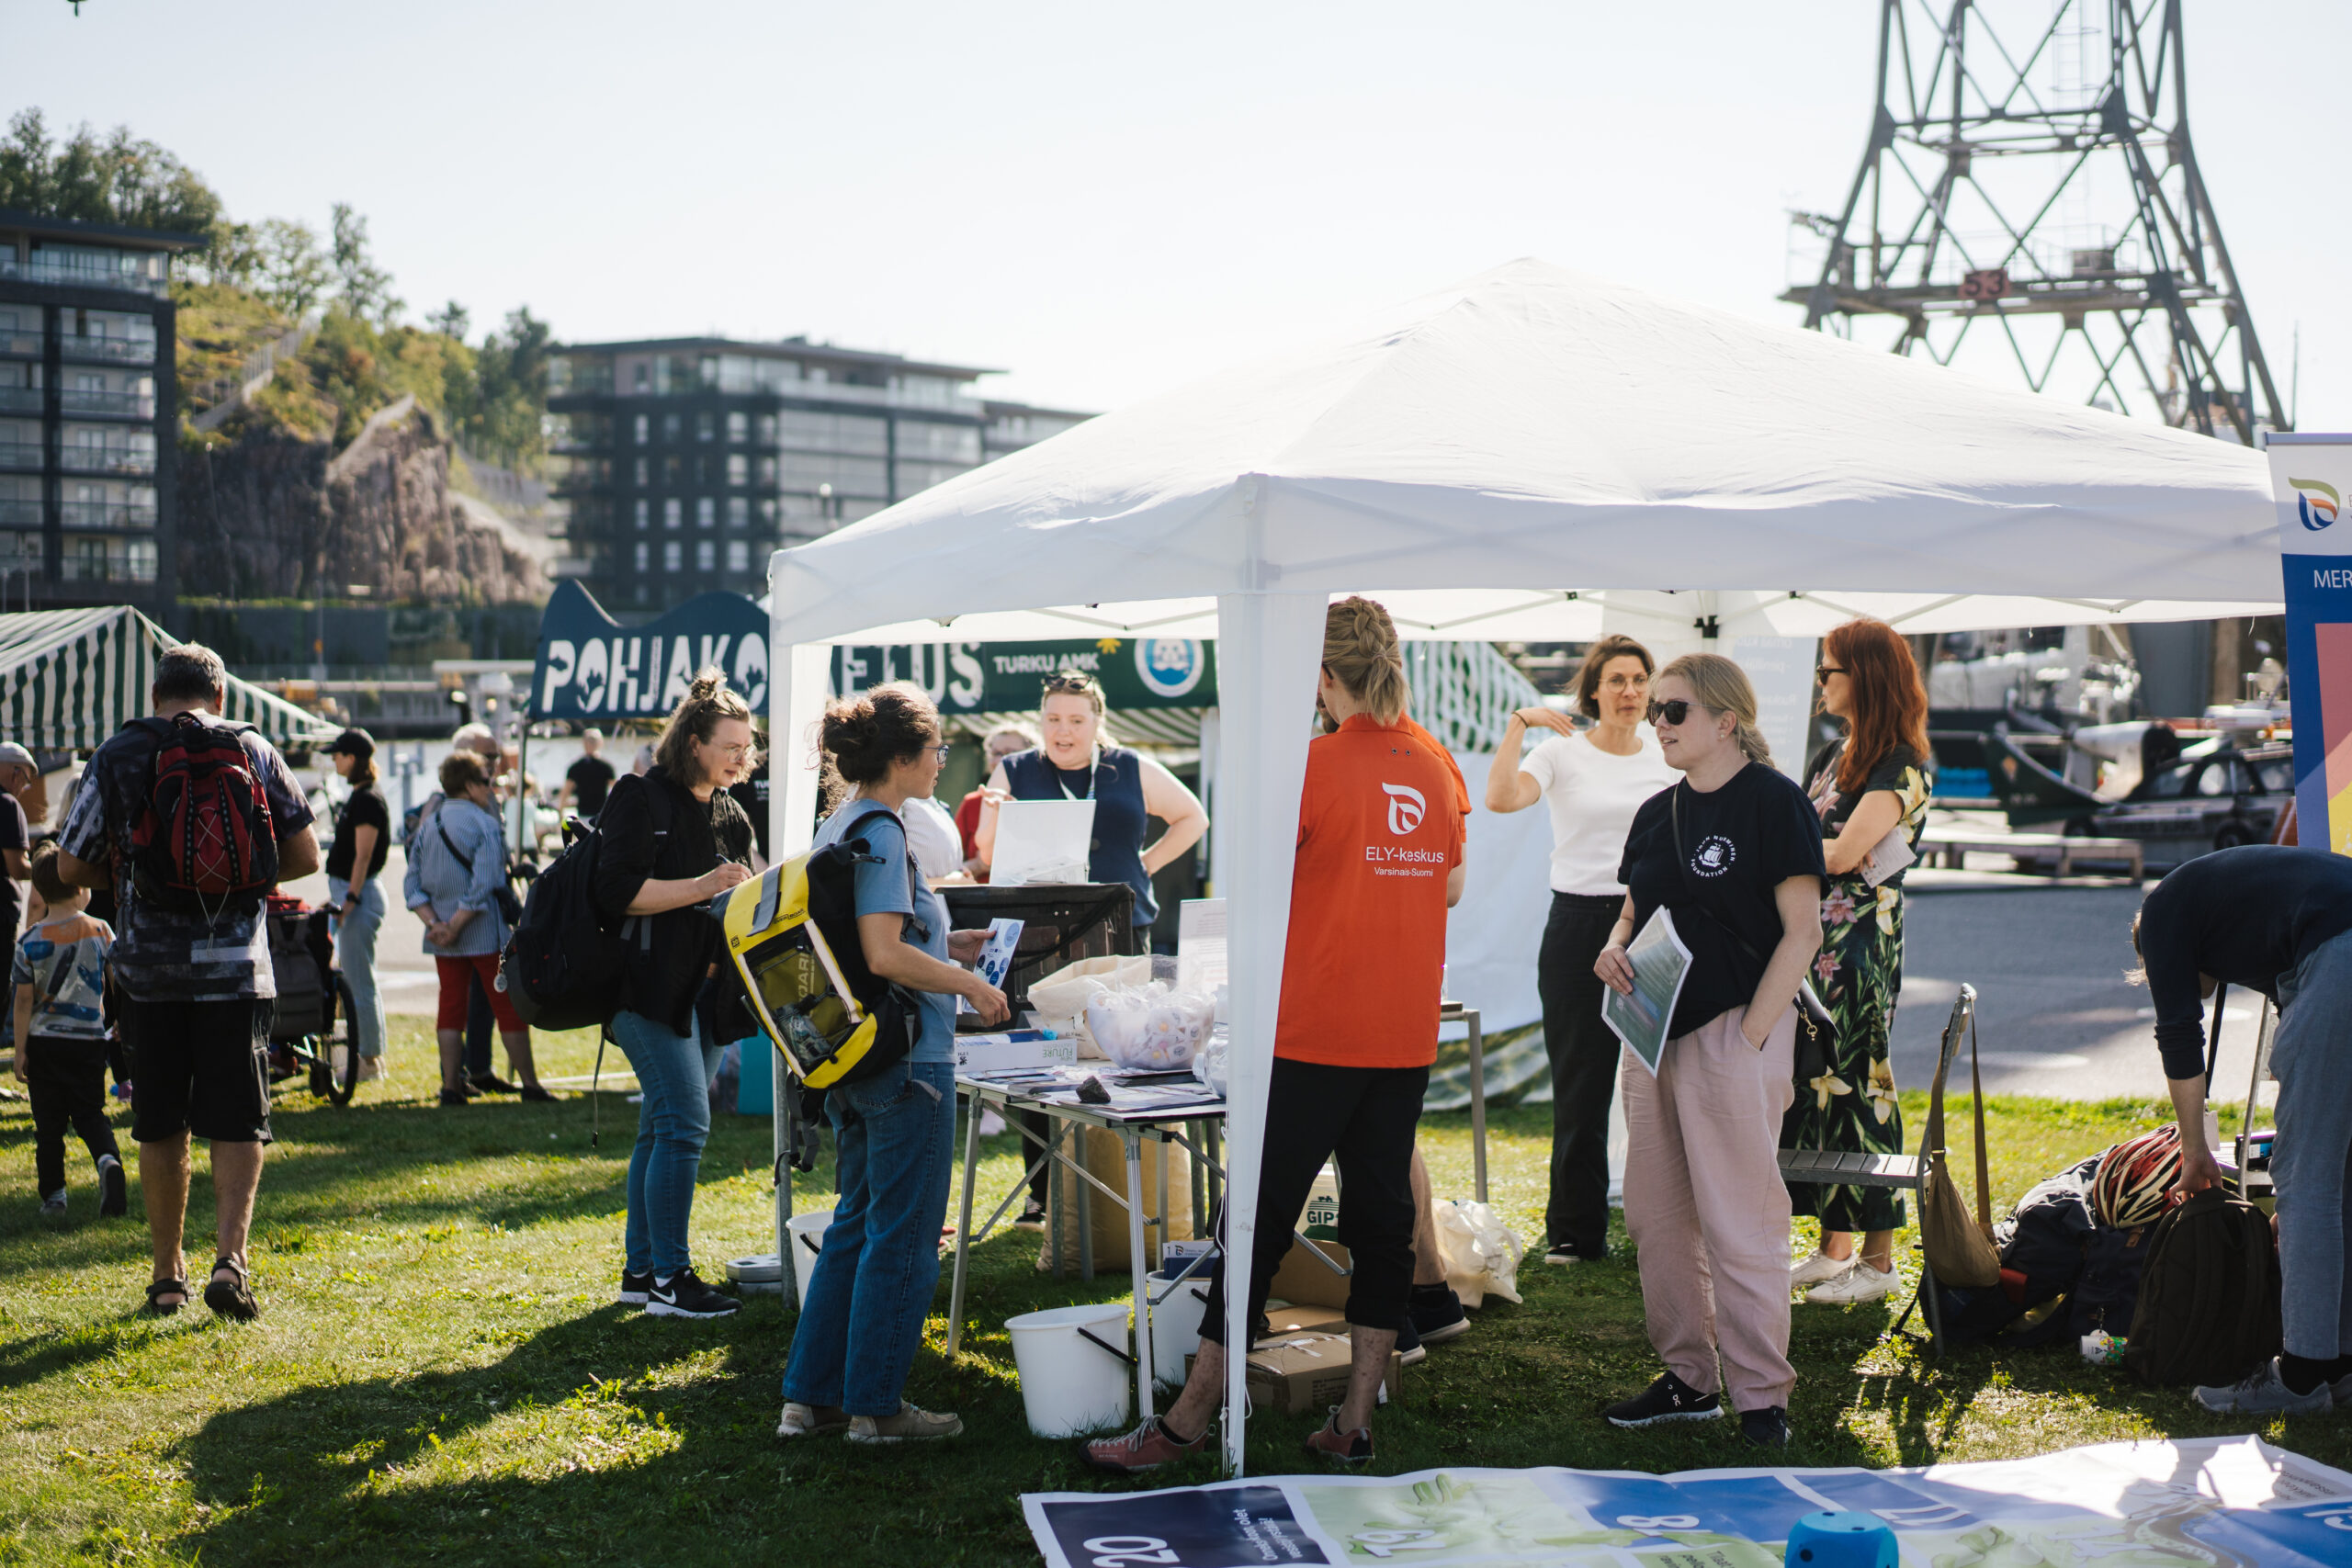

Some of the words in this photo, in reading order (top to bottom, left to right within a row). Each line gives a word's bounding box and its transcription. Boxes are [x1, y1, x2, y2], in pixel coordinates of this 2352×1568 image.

[1965, 271, 2004, 296] 53
[993, 655, 1056, 674] TURKU
[1057, 651, 1101, 671] AMK
[1365, 846, 1444, 863] ELY-keskus
[1374, 866, 1433, 877] Varsinais-Suomi
[1690, 859, 1728, 877] FOUNDATION
[1307, 1211, 1340, 1224] GIP
[1617, 1515, 1713, 1537] 18
[1083, 1536, 1181, 1568] 20
[1352, 1529, 1447, 1558] 19
